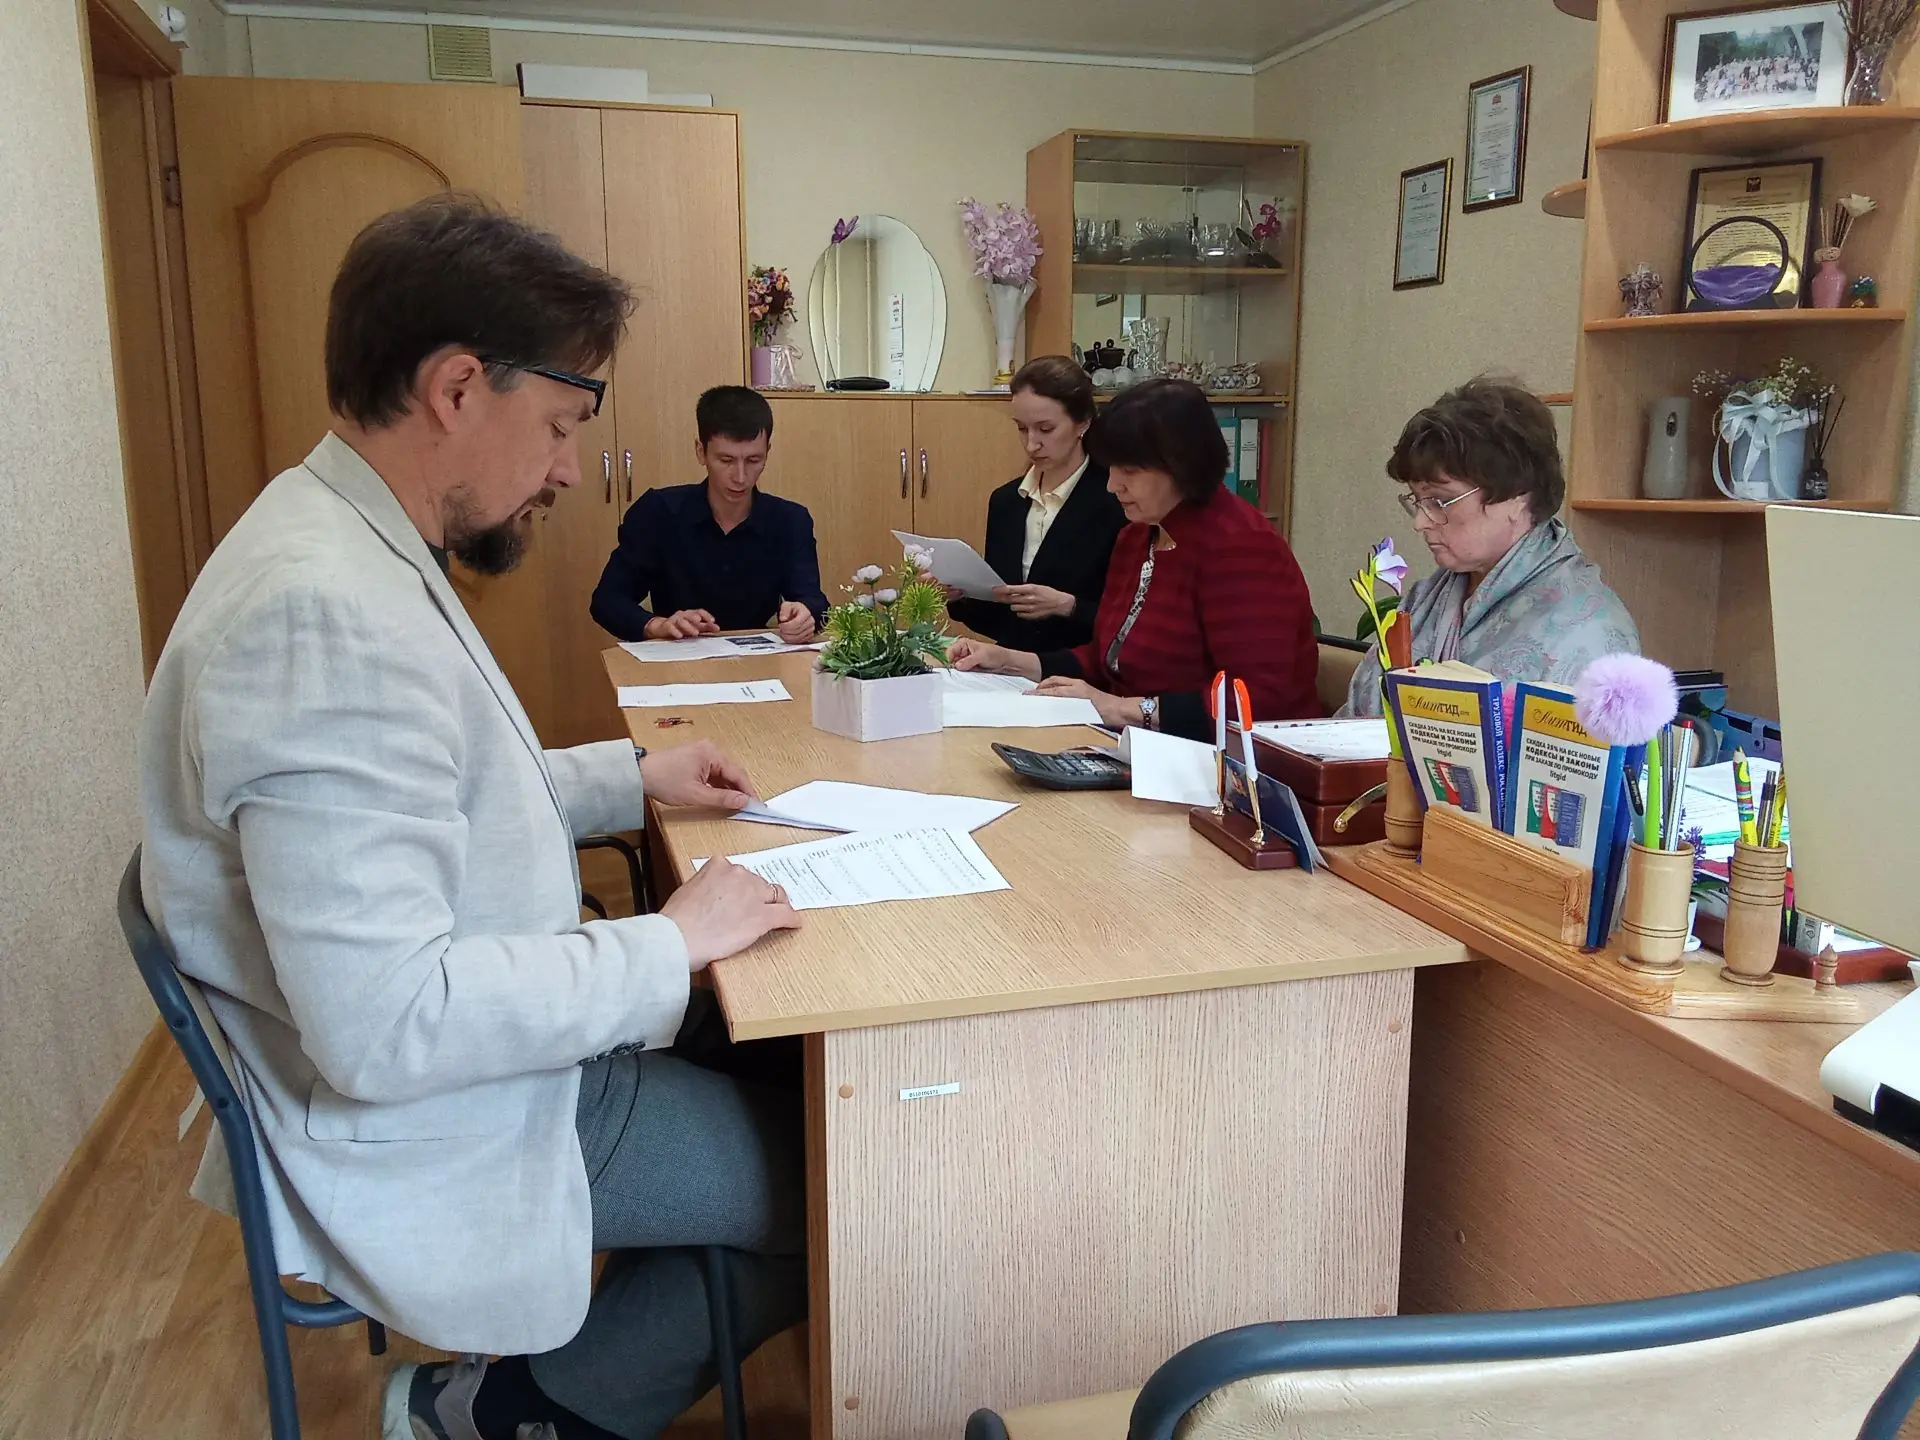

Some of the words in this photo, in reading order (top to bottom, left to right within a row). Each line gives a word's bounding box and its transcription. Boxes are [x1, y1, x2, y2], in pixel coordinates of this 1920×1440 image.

[1492, 696, 1503, 737] ТРУДОВОЙ
[1408, 721, 1427, 731] СКИДКА
[1446, 728, 1457, 736] ВСЕ
[1457, 730, 1476, 739] НОВЫЕ
[1410, 728, 1440, 740] КОДЕКСЫ
[1440, 733, 1446, 741] И
[1447, 735, 1477, 746] ЗАКОНЫ
[1445, 742, 1478, 754] ПРОМОКОДУ
[1495, 739, 1505, 772] КОДЕКС
[1526, 738, 1546, 749] СКИДКА
[1559, 746, 1567, 755] НА
[1567, 748, 1579, 758] ВСЕ
[1579, 751, 1601, 764] НОВЫЕ
[1526, 746, 1558, 760] КОДЕКСЫ
[1559, 754, 1566, 762] И
[1566, 756, 1600, 771] ЗАКОНЫ
[1525, 754, 1535, 762] ПРИ
[1535, 756, 1554, 768] ЗАКАЗЕ
[1554, 761, 1562, 770] ПО
[1562, 763, 1599, 780] ПРОМОКОДУ
[1550, 770, 1567, 782] litgid
